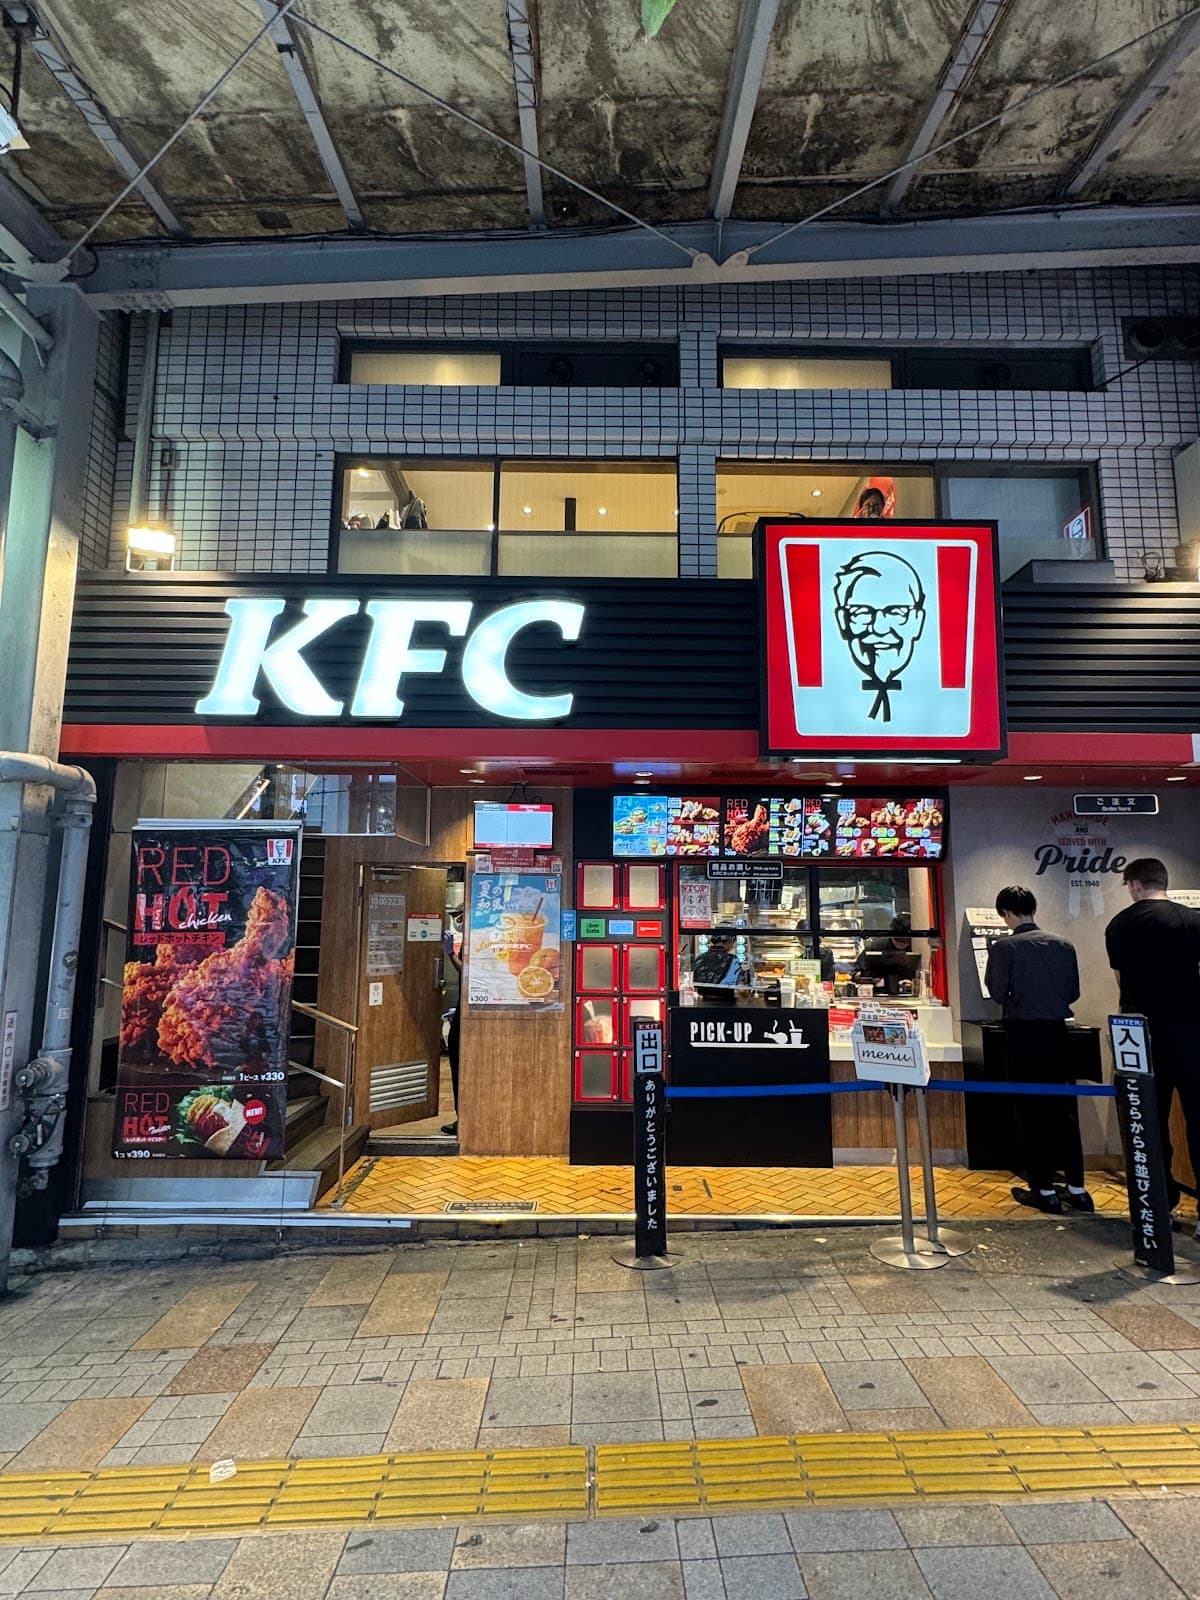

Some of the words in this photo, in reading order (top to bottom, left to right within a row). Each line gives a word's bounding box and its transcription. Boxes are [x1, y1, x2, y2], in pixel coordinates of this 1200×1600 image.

[195, 599, 585, 720] KFC
[726, 799, 748, 808] RED
[1096, 797, 1136, 806] ご注文
[1057, 838, 1086, 847] SERVED
[1088, 838, 1107, 847] WITH
[137, 846, 231, 886] RED
[711, 863, 752, 871] 商品お渡し
[1034, 844, 1127, 875] Pride
[681, 884, 707, 892] STOP
[135, 886, 228, 930] HOT
[179, 912, 232, 930] chicken
[690, 1022, 752, 1042] PICK-UP
[641, 1032, 657, 1070] 出口
[862, 1049, 911, 1061] menu
[1118, 1028, 1141, 1069] 入口
[239, 1072, 259, 1081] 1ピース
[261, 1072, 285, 1081] ¥330
[124, 1092, 170, 1113] RED
[122, 1113, 169, 1137] HOT
[126, 1150, 151, 1159] ¥390
[645, 1079, 658, 1230] ありがとうございました
[1126, 1078, 1158, 1250] こちらからお並びください
